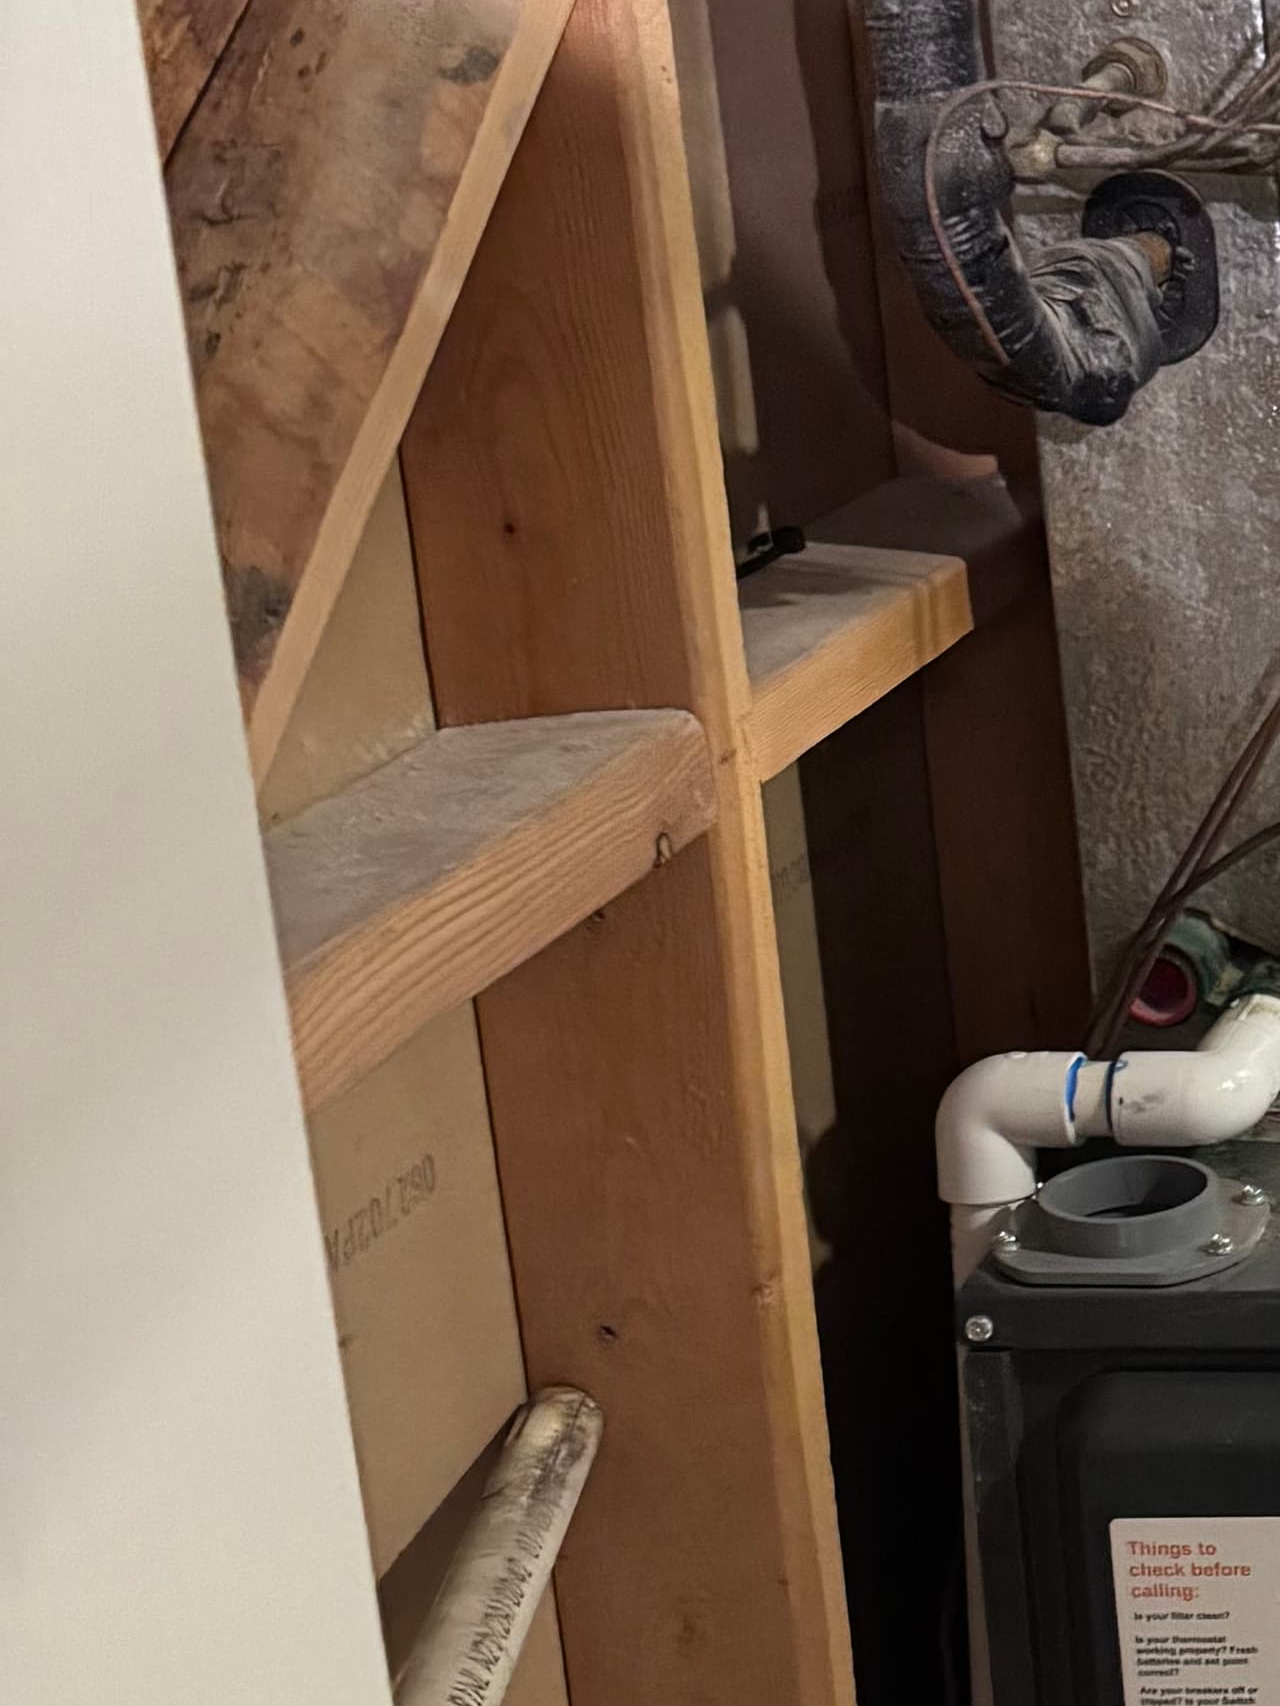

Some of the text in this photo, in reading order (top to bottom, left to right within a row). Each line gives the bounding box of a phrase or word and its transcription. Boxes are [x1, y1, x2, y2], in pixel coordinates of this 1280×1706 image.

[1128, 1541, 1217, 1559] Things to
[1129, 1562, 1251, 1577] check before
[1131, 1584, 1199, 1601] calling:
